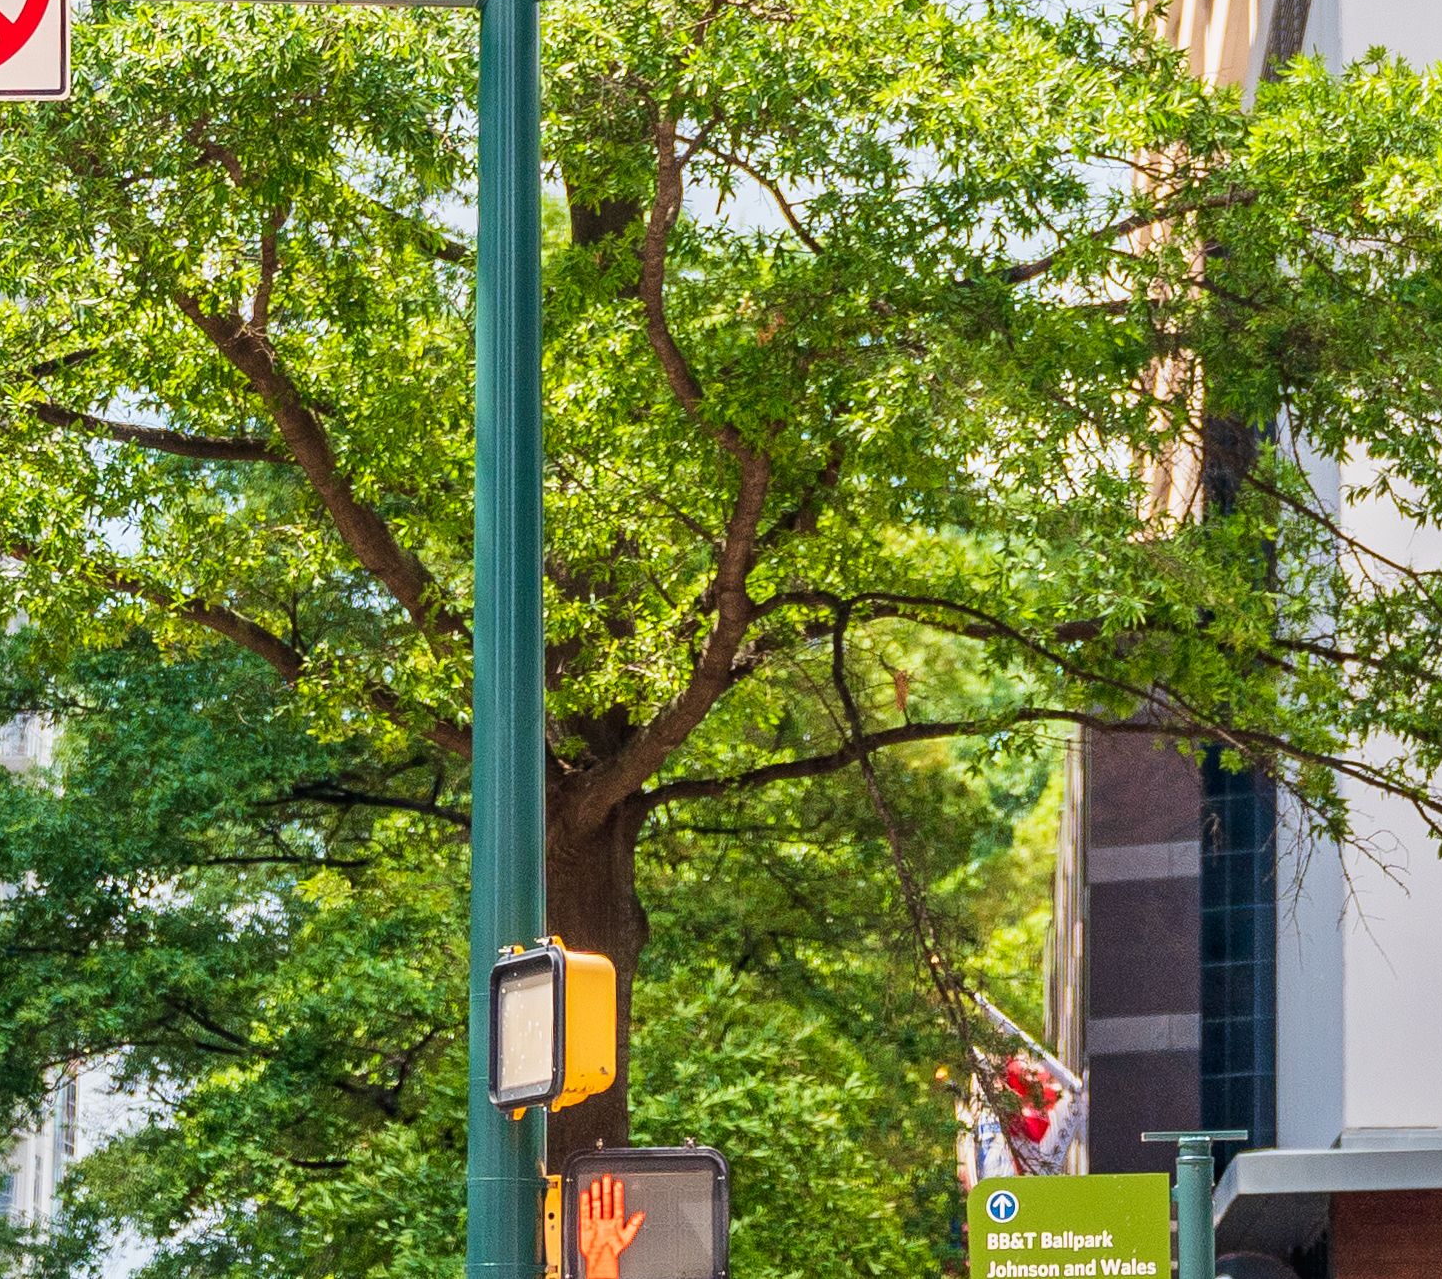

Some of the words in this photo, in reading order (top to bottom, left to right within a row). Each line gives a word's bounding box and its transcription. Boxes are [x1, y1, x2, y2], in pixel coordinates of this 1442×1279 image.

[987, 1232, 1037, 1249] BB&T
[1041, 1231, 1113, 1251] Ballpark
[987, 1261, 1060, 1278] Johnson
[1063, 1259, 1096, 1276] and
[1100, 1258, 1157, 1275] Wales
